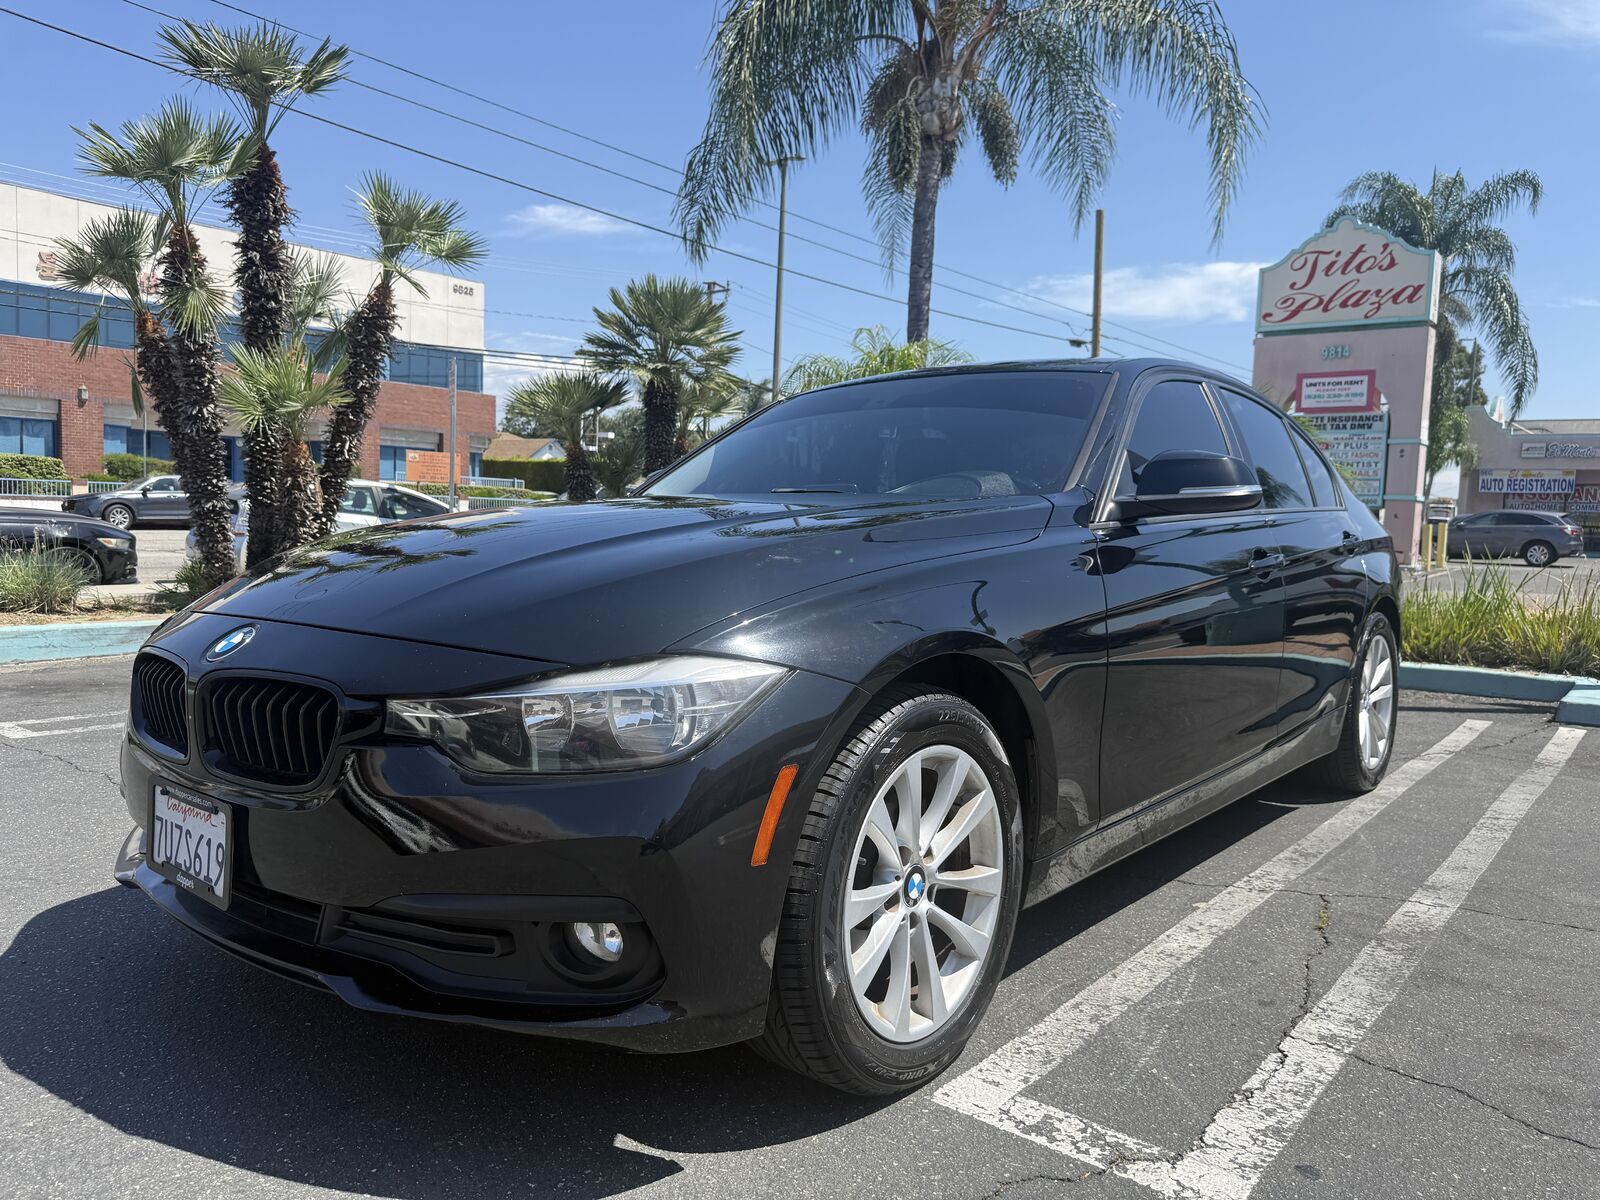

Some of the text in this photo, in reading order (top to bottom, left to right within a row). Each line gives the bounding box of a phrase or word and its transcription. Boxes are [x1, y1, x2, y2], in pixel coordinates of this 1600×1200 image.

[1289, 243, 1399, 291] Tito's
[1262, 278, 1425, 323] Plaza
[1321, 346, 1351, 360] 9814
[1327, 415, 1384, 423] INSURANCE
[1350, 422, 1373, 430] DMV
[1344, 442, 1369, 450] PLUS
[1480, 478, 1575, 492] AUTO REGISTRATION
[167, 797, 217, 827] California
[156, 815, 225, 887] 7UZS619
